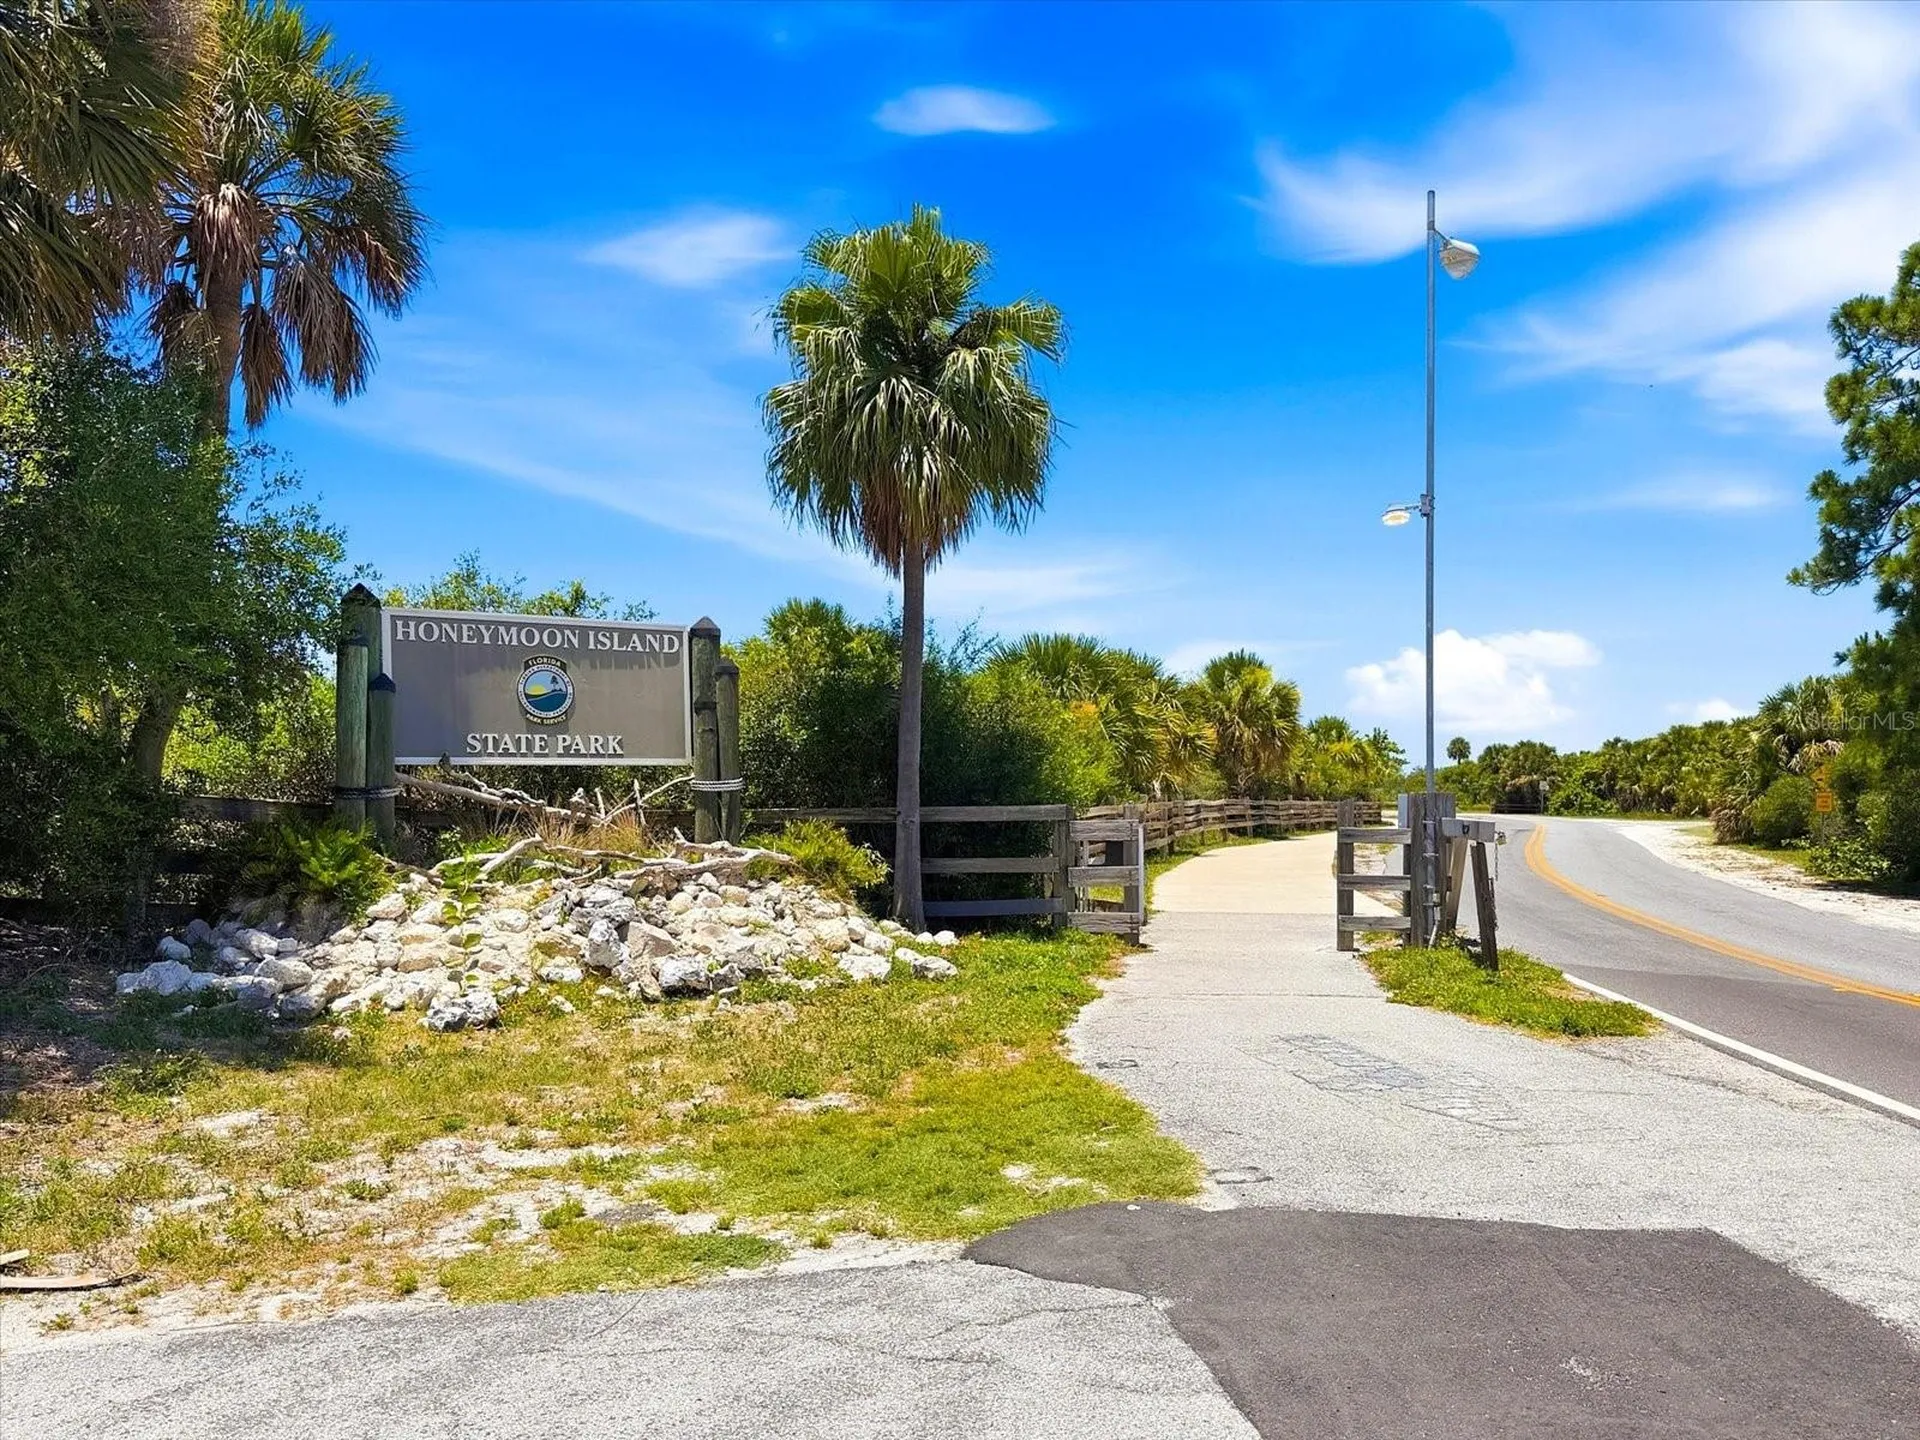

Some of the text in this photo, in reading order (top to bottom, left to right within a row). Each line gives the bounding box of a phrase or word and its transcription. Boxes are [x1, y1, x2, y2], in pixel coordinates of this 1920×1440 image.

[395, 620, 680, 653] HONEYMOON ISLAND
[528, 657, 561, 667] FLORIDA
[526, 713, 541, 724] PARK
[466, 733, 624, 754] STATE PARK
